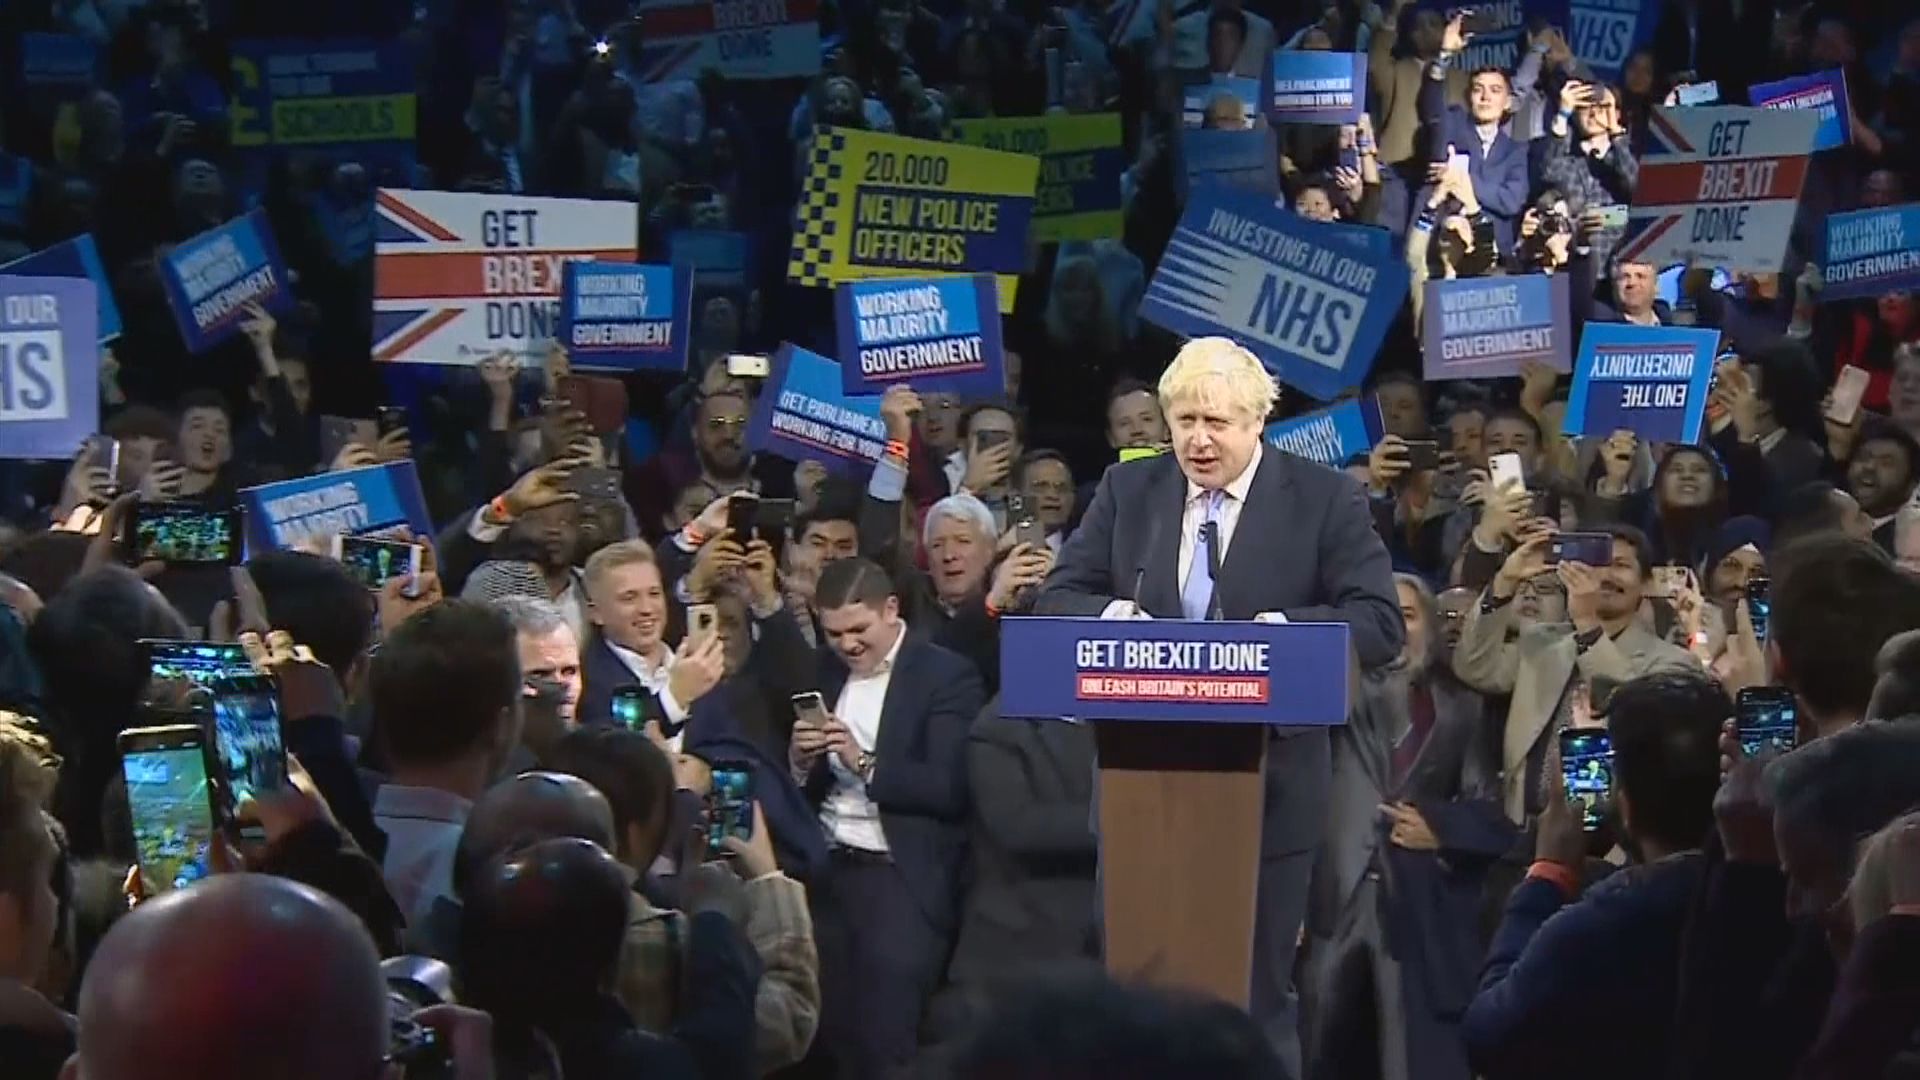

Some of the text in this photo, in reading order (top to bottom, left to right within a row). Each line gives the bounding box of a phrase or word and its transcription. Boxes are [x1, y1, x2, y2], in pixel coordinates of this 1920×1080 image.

[277, 102, 394, 138] SCHOOLS
[1708, 120, 1751, 157] GET
[1698, 160, 1779, 199] BREXIT
[482, 210, 538, 247] GET
[858, 194, 999, 233] NEW POLICE
[1691, 206, 1750, 243] DONE
[1831, 212, 1902, 243] WORKING
[855, 229, 966, 265] OFFICERS
[1206, 208, 1378, 292] INVESTING IN OUR
[1829, 230, 1904, 261] MAJORITY
[5, 294, 58, 325] OUR
[193, 263, 278, 327] GOVERNMENT
[856, 285, 942, 317] WORKING
[1441, 284, 1518, 312] WORKING
[860, 309, 948, 342] MAJORITY
[1248, 273, 1353, 356] NHS
[1442, 303, 1522, 336] MAJORITY
[573, 322, 672, 345] GOVERNMENT
[1441, 328, 1554, 360] GOVERNMENT
[861, 336, 983, 373] GOVERNMENT
[1589, 353, 1695, 378] UNCERTAINTY
[780, 390, 808, 412] GET
[1621, 384, 1688, 408] END THE
[772, 411, 832, 443] WORKING
[829, 431, 857, 453] FOR
[1076, 640, 1270, 671] GET BREXIT DONE
[1081, 677, 1263, 698] UNLEASH BRITAIN'S POTENTIAL
